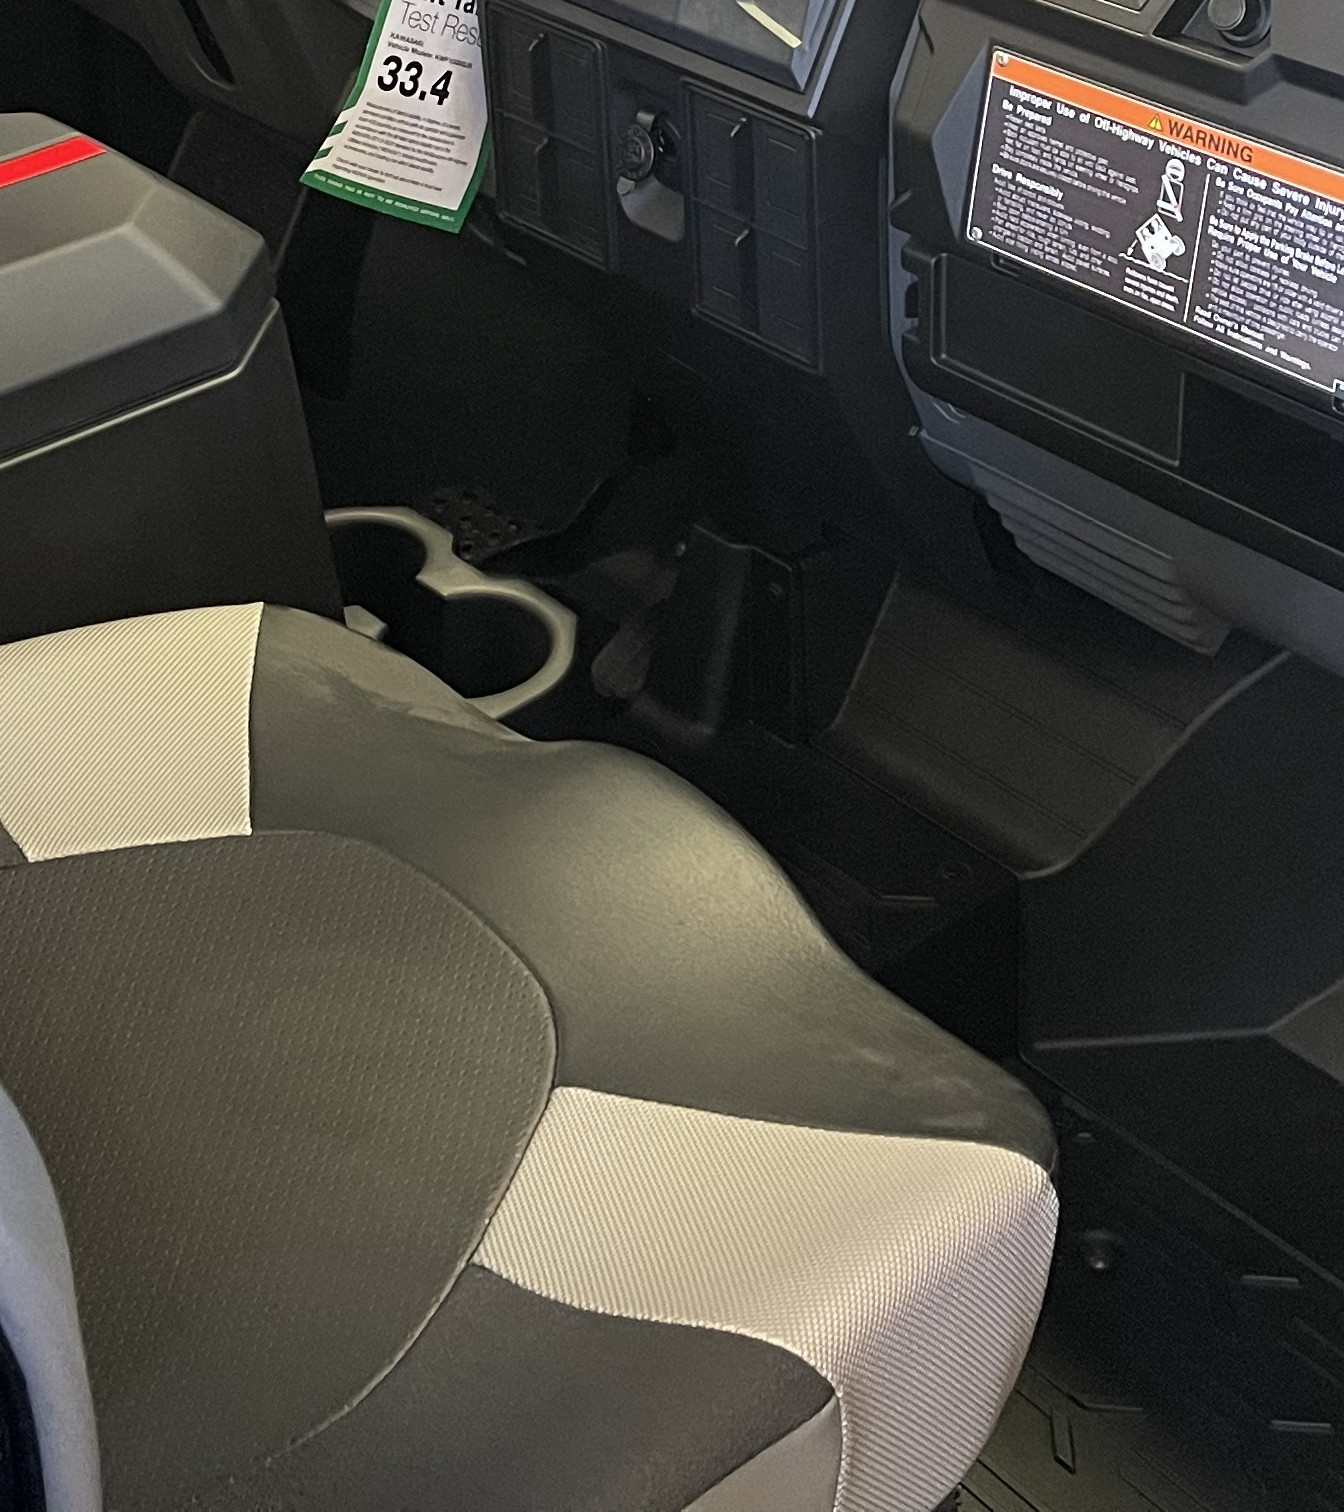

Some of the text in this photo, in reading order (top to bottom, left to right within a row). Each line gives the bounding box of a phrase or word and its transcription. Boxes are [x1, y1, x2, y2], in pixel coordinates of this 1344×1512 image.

[401, 0, 439, 34] Test
[377, 55, 453, 106] 33.4
[1002, 99, 1053, 126] Be Prepared
[1009, 85, 1052, 109] Improper
[1056, 102, 1076, 119] Use
[1079, 112, 1091, 124] of
[1094, 116, 1155, 150] Off-Highway
[1159, 139, 1202, 166] Vehicles
[1206, 157, 1229, 175] Can
[1233, 167, 1267, 190] Cause
[1272, 181, 1310, 206] Severe
[1168, 119, 1254, 164] WARNING
[991, 163, 1064, 201] Drive Responsibly
[1285, 202, 1299, 217] Pay
